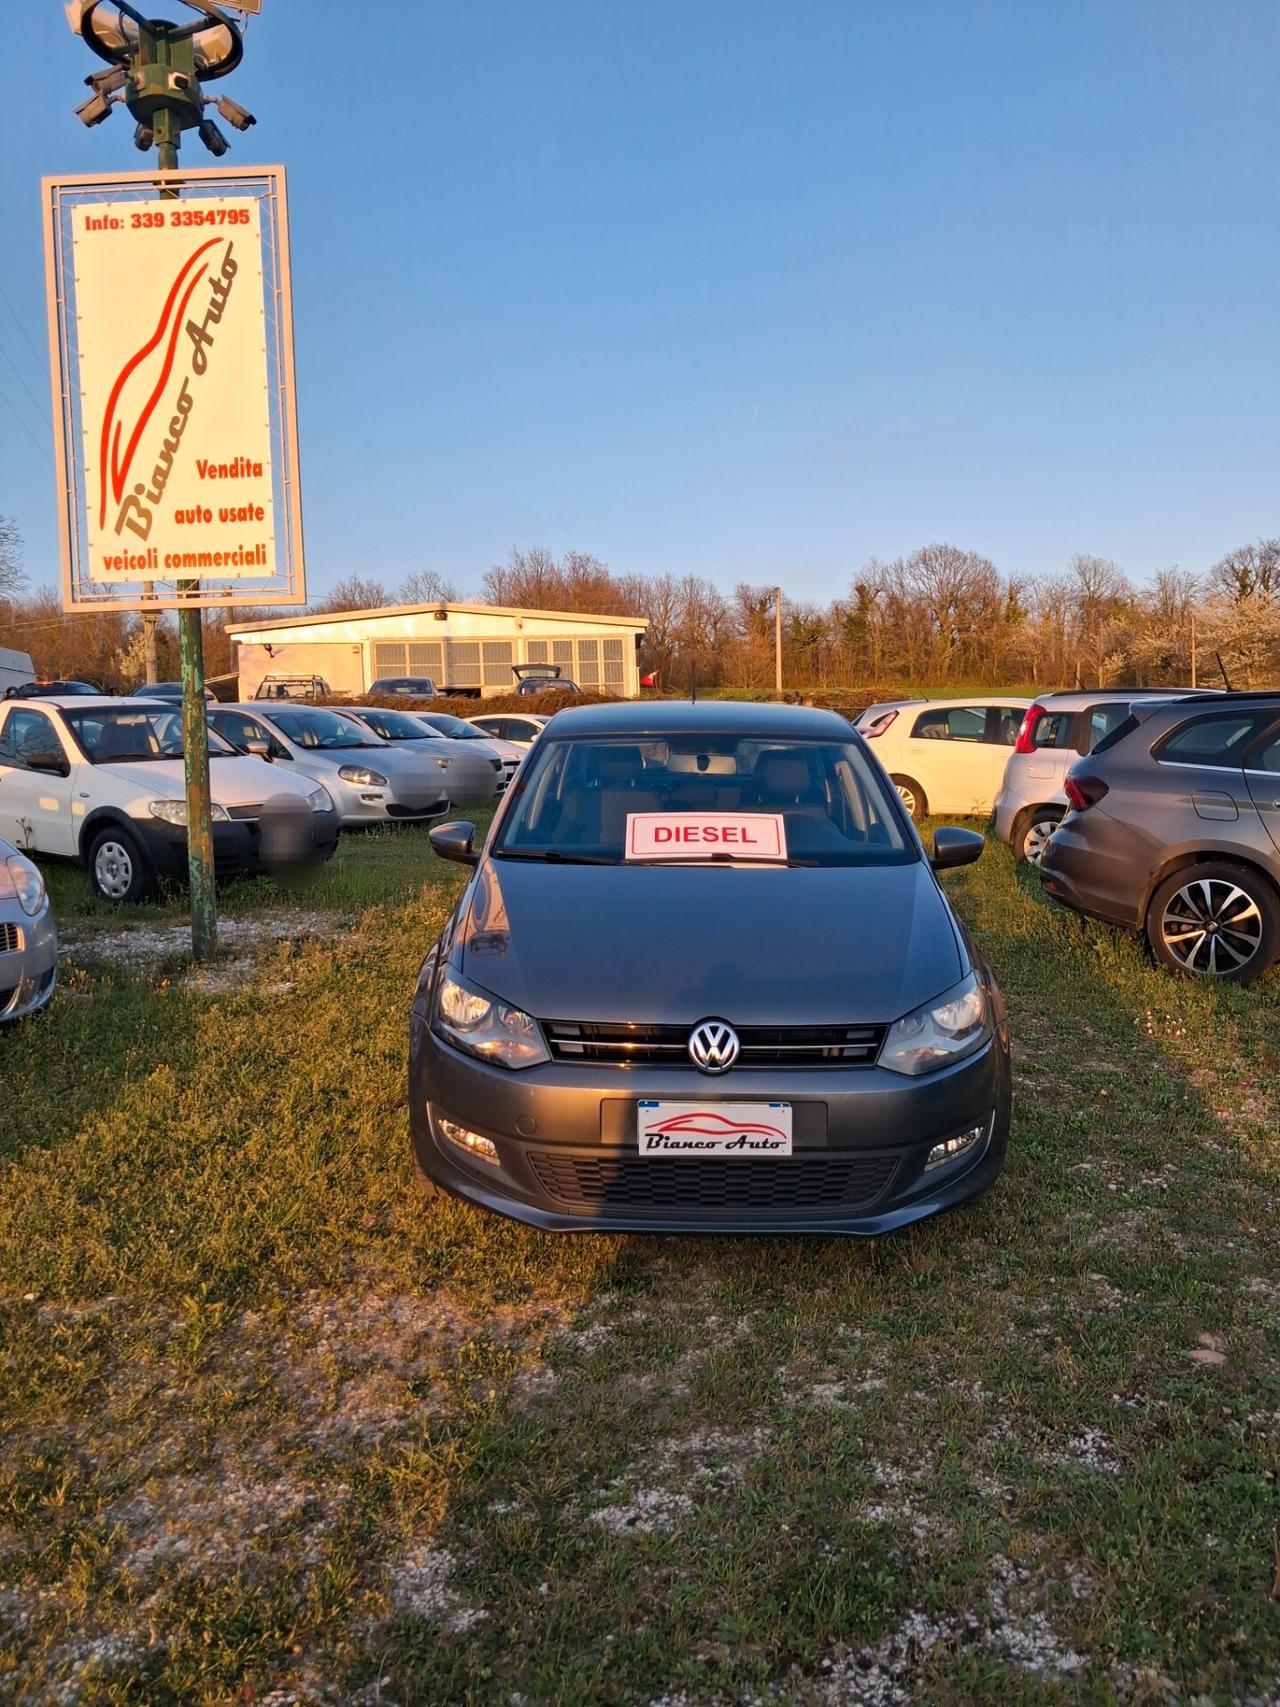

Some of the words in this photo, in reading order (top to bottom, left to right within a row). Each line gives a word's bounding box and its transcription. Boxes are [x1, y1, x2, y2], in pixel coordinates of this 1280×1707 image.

[85, 215, 125, 231] Info:
[130, 213, 165, 228] 339
[170, 209, 250, 227] 3354795
[114, 376, 193, 541] Bianco
[186, 241, 238, 376] Auto
[196, 457, 263, 479] Vendita
[174, 505, 213, 524] auto
[219, 503, 264, 523] usate
[103, 548, 159, 571] veicoli
[164, 544, 267, 569] commerciali
[654, 826, 757, 844] DIESEL
[645, 1133, 722, 1152] Bianco
[725, 1134, 787, 1151] Auto
